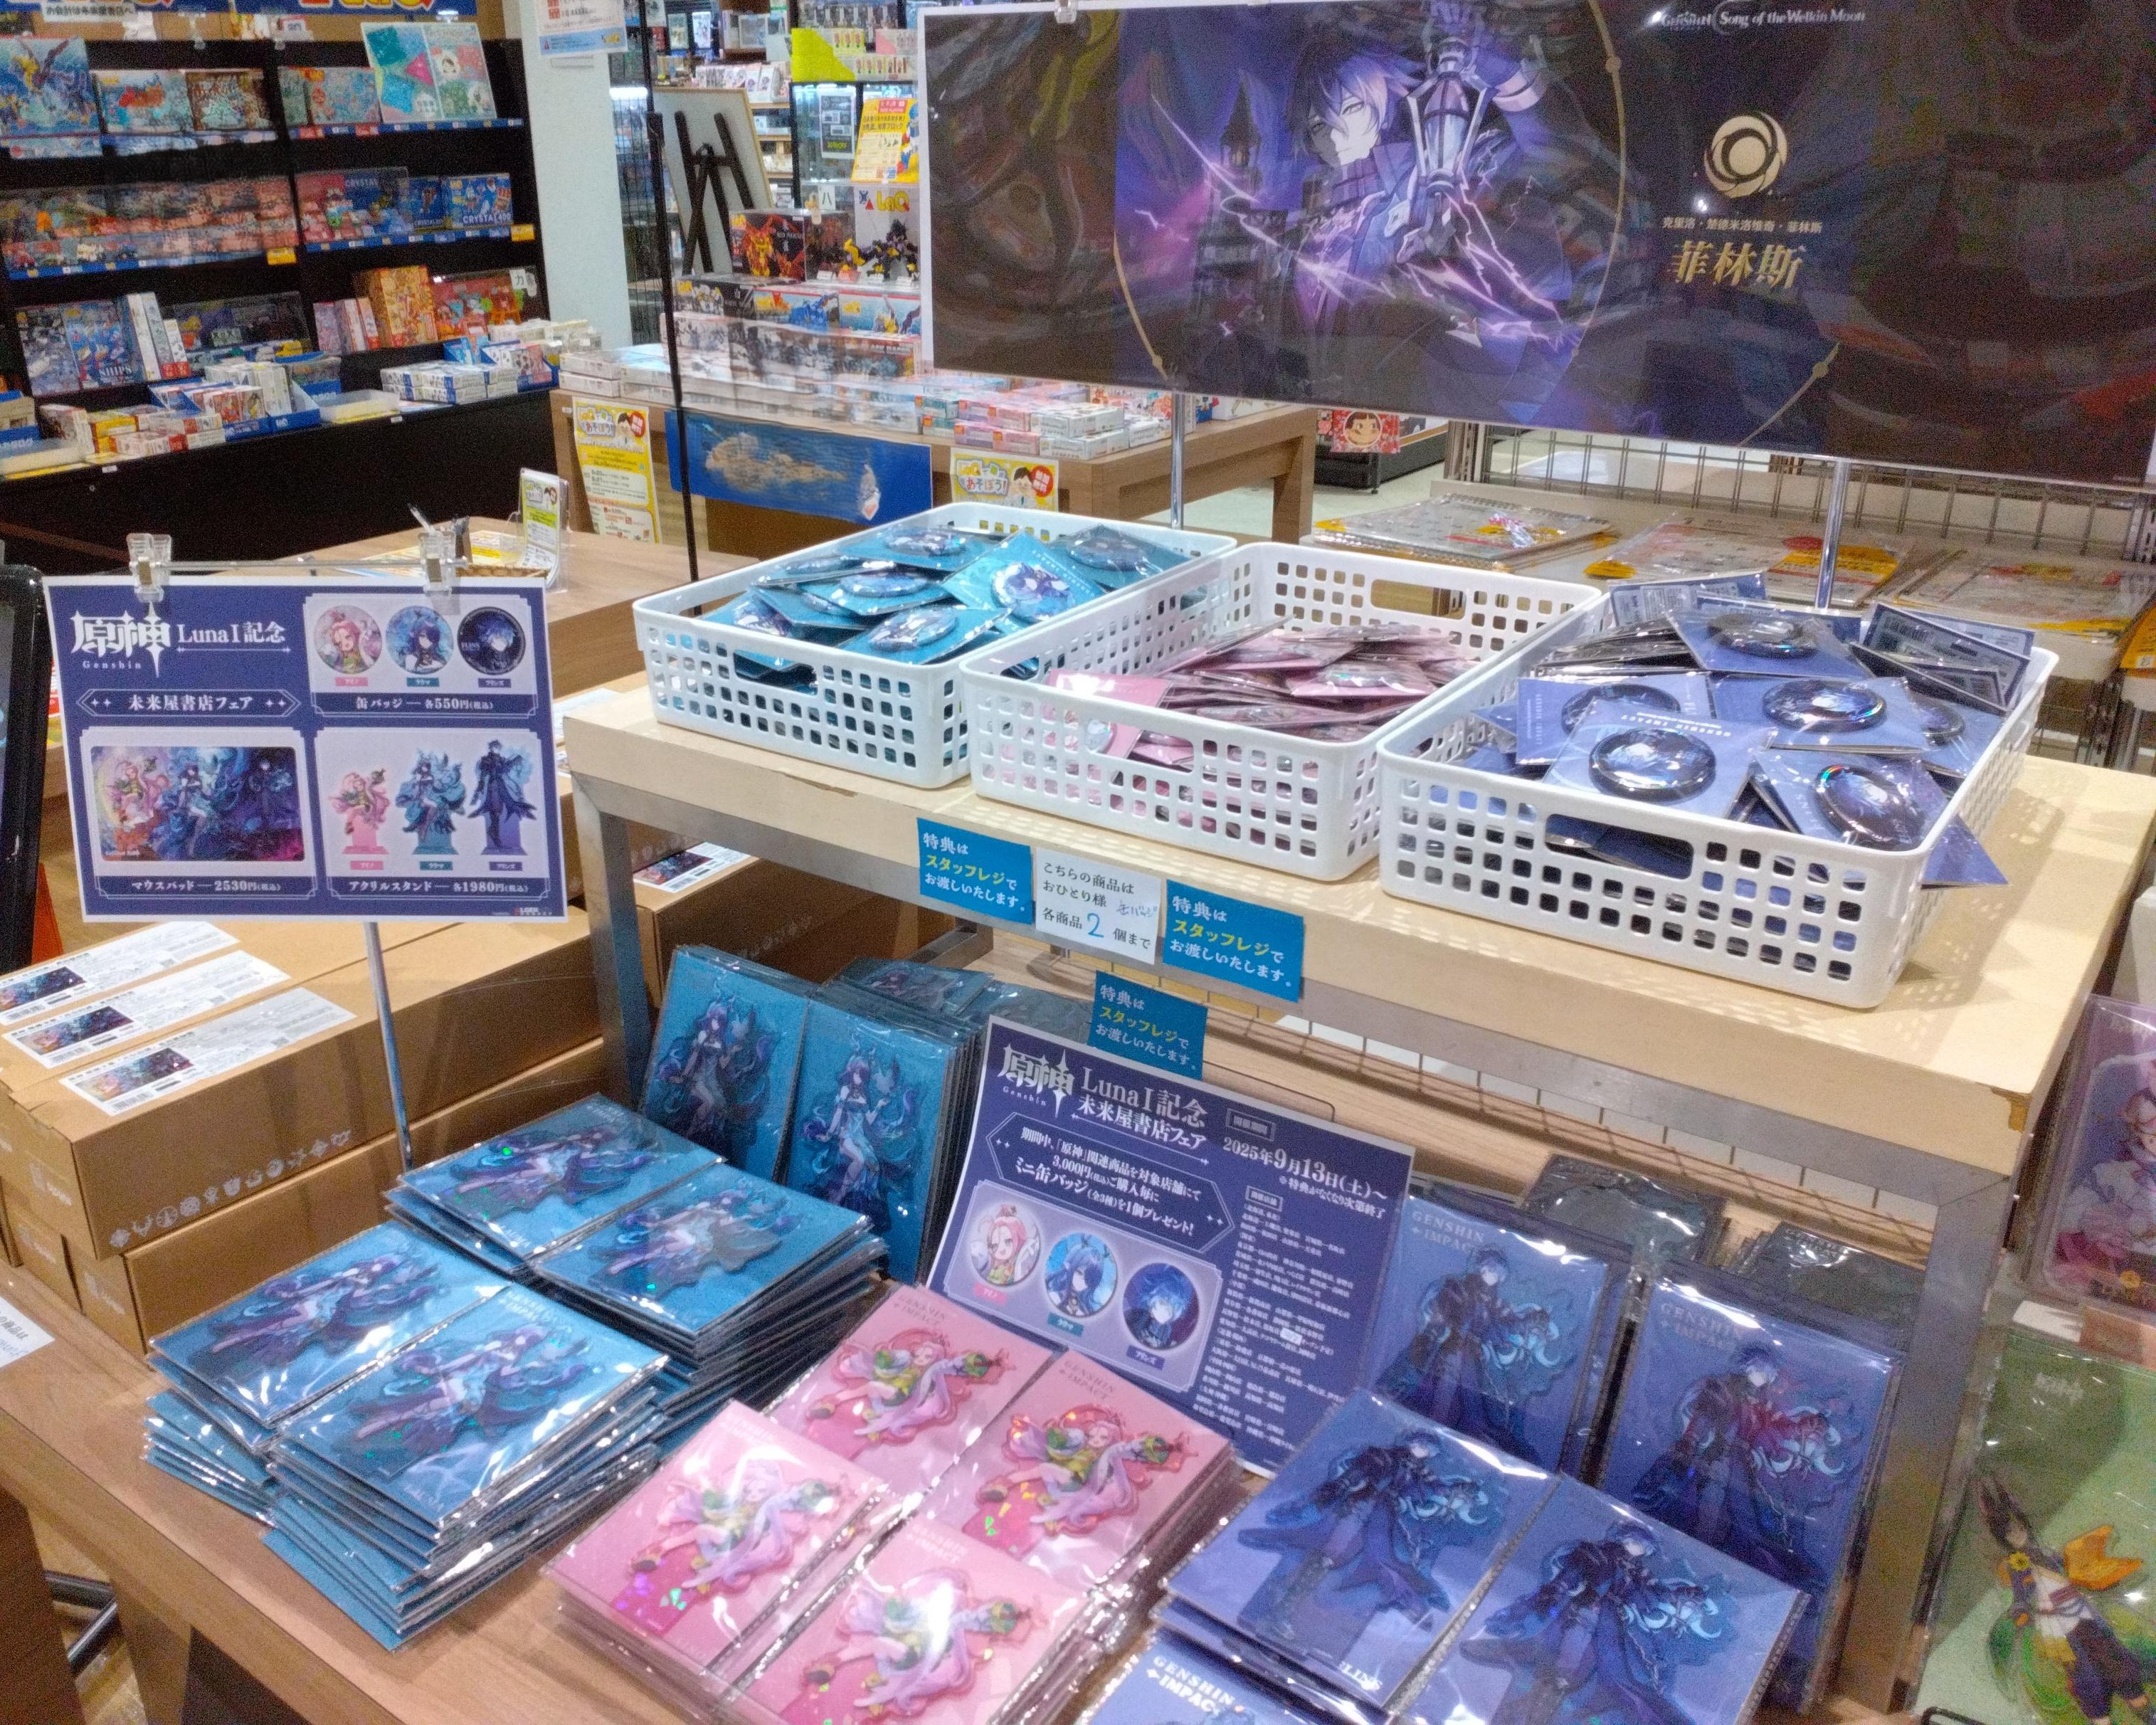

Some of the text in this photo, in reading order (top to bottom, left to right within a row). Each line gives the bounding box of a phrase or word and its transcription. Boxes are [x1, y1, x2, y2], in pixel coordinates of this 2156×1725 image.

[1720, 11, 1749, 28] Song
[1752, 11, 1765, 26] of
[1767, 11, 1785, 23] the
[1830, 9, 1866, 22] Moon
[1668, 240, 1806, 289] 菲林斯
[70, 602, 171, 677] 原神
[83, 659, 142, 670] Genshin
[128, 694, 254, 712] 未来屋書店フェア
[923, 832, 968, 855] 特典は
[349, 880, 432, 892] アクリルスタンド
[926, 855, 1017, 890] スタッフレジで
[1044, 862, 1134, 895] こちらの商品は
[925, 873, 1025, 912] お渡しいたします。
[1042, 880, 1106, 907] おひとり様
[1172, 895, 1227, 922] 特典は
[1042, 907, 1151, 949] 各商品 2 個まで
[1173, 919, 1284, 964] スタッフレジで
[1170, 939, 1291, 987] お渡しいたします。
[1100, 985, 1144, 1010] 特典は
[1096, 1024, 1195, 1070] お渡しいたします。
[1099, 1007, 1189, 1050] スタッフレジで
[998, 1044, 1075, 1118] 原神
[1003, 1085, 1047, 1106] Genshin
[1077, 1094, 1207, 1150] 未来屋書店フェア
[1153, 1655, 1236, 1706] GENSHIN
